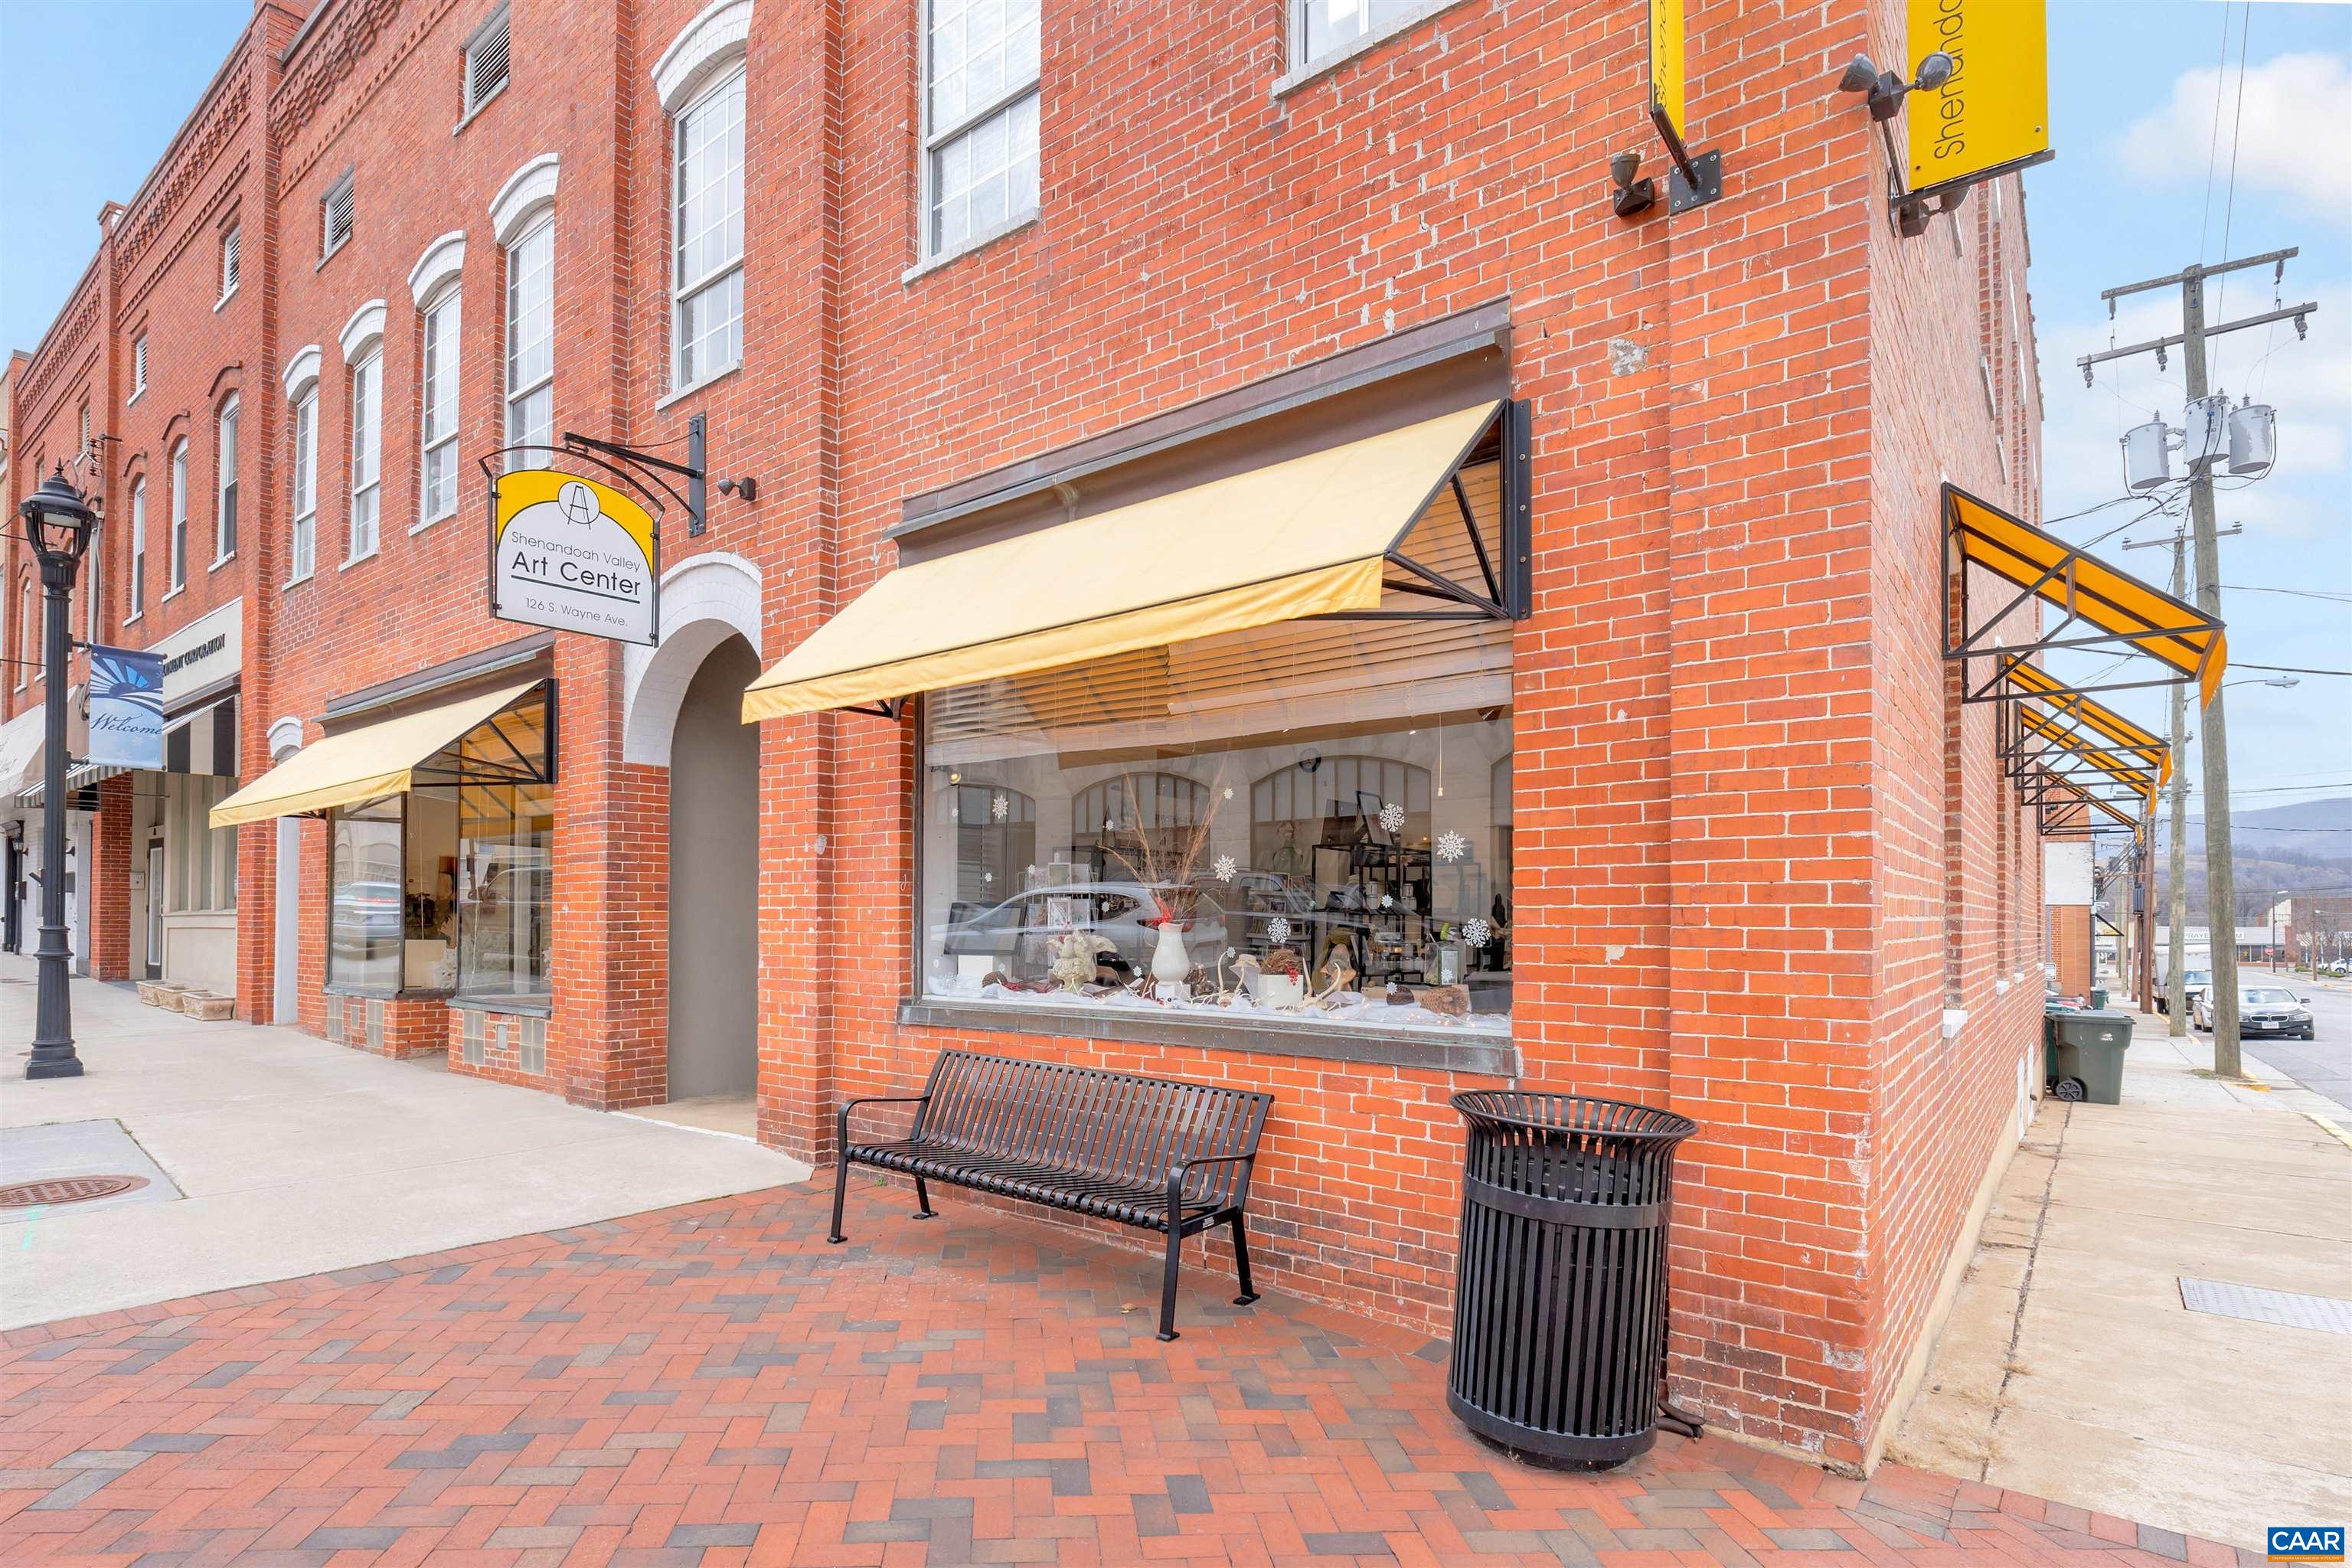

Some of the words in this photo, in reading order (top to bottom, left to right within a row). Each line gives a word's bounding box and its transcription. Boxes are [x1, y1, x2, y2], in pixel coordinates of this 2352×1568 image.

[1932, 0, 1965, 158] Shenando
[511, 531, 599, 562] Shenandoah
[603, 553, 640, 572] Valley
[511, 551, 548, 576] Art
[560, 561, 640, 596] Center
[526, 597, 544, 611] 126
[548, 602, 557, 613] S.
[561, 605, 601, 622] Wayne
[604, 613, 629, 626] Ave.
[90, 713, 162, 735] Welcome
